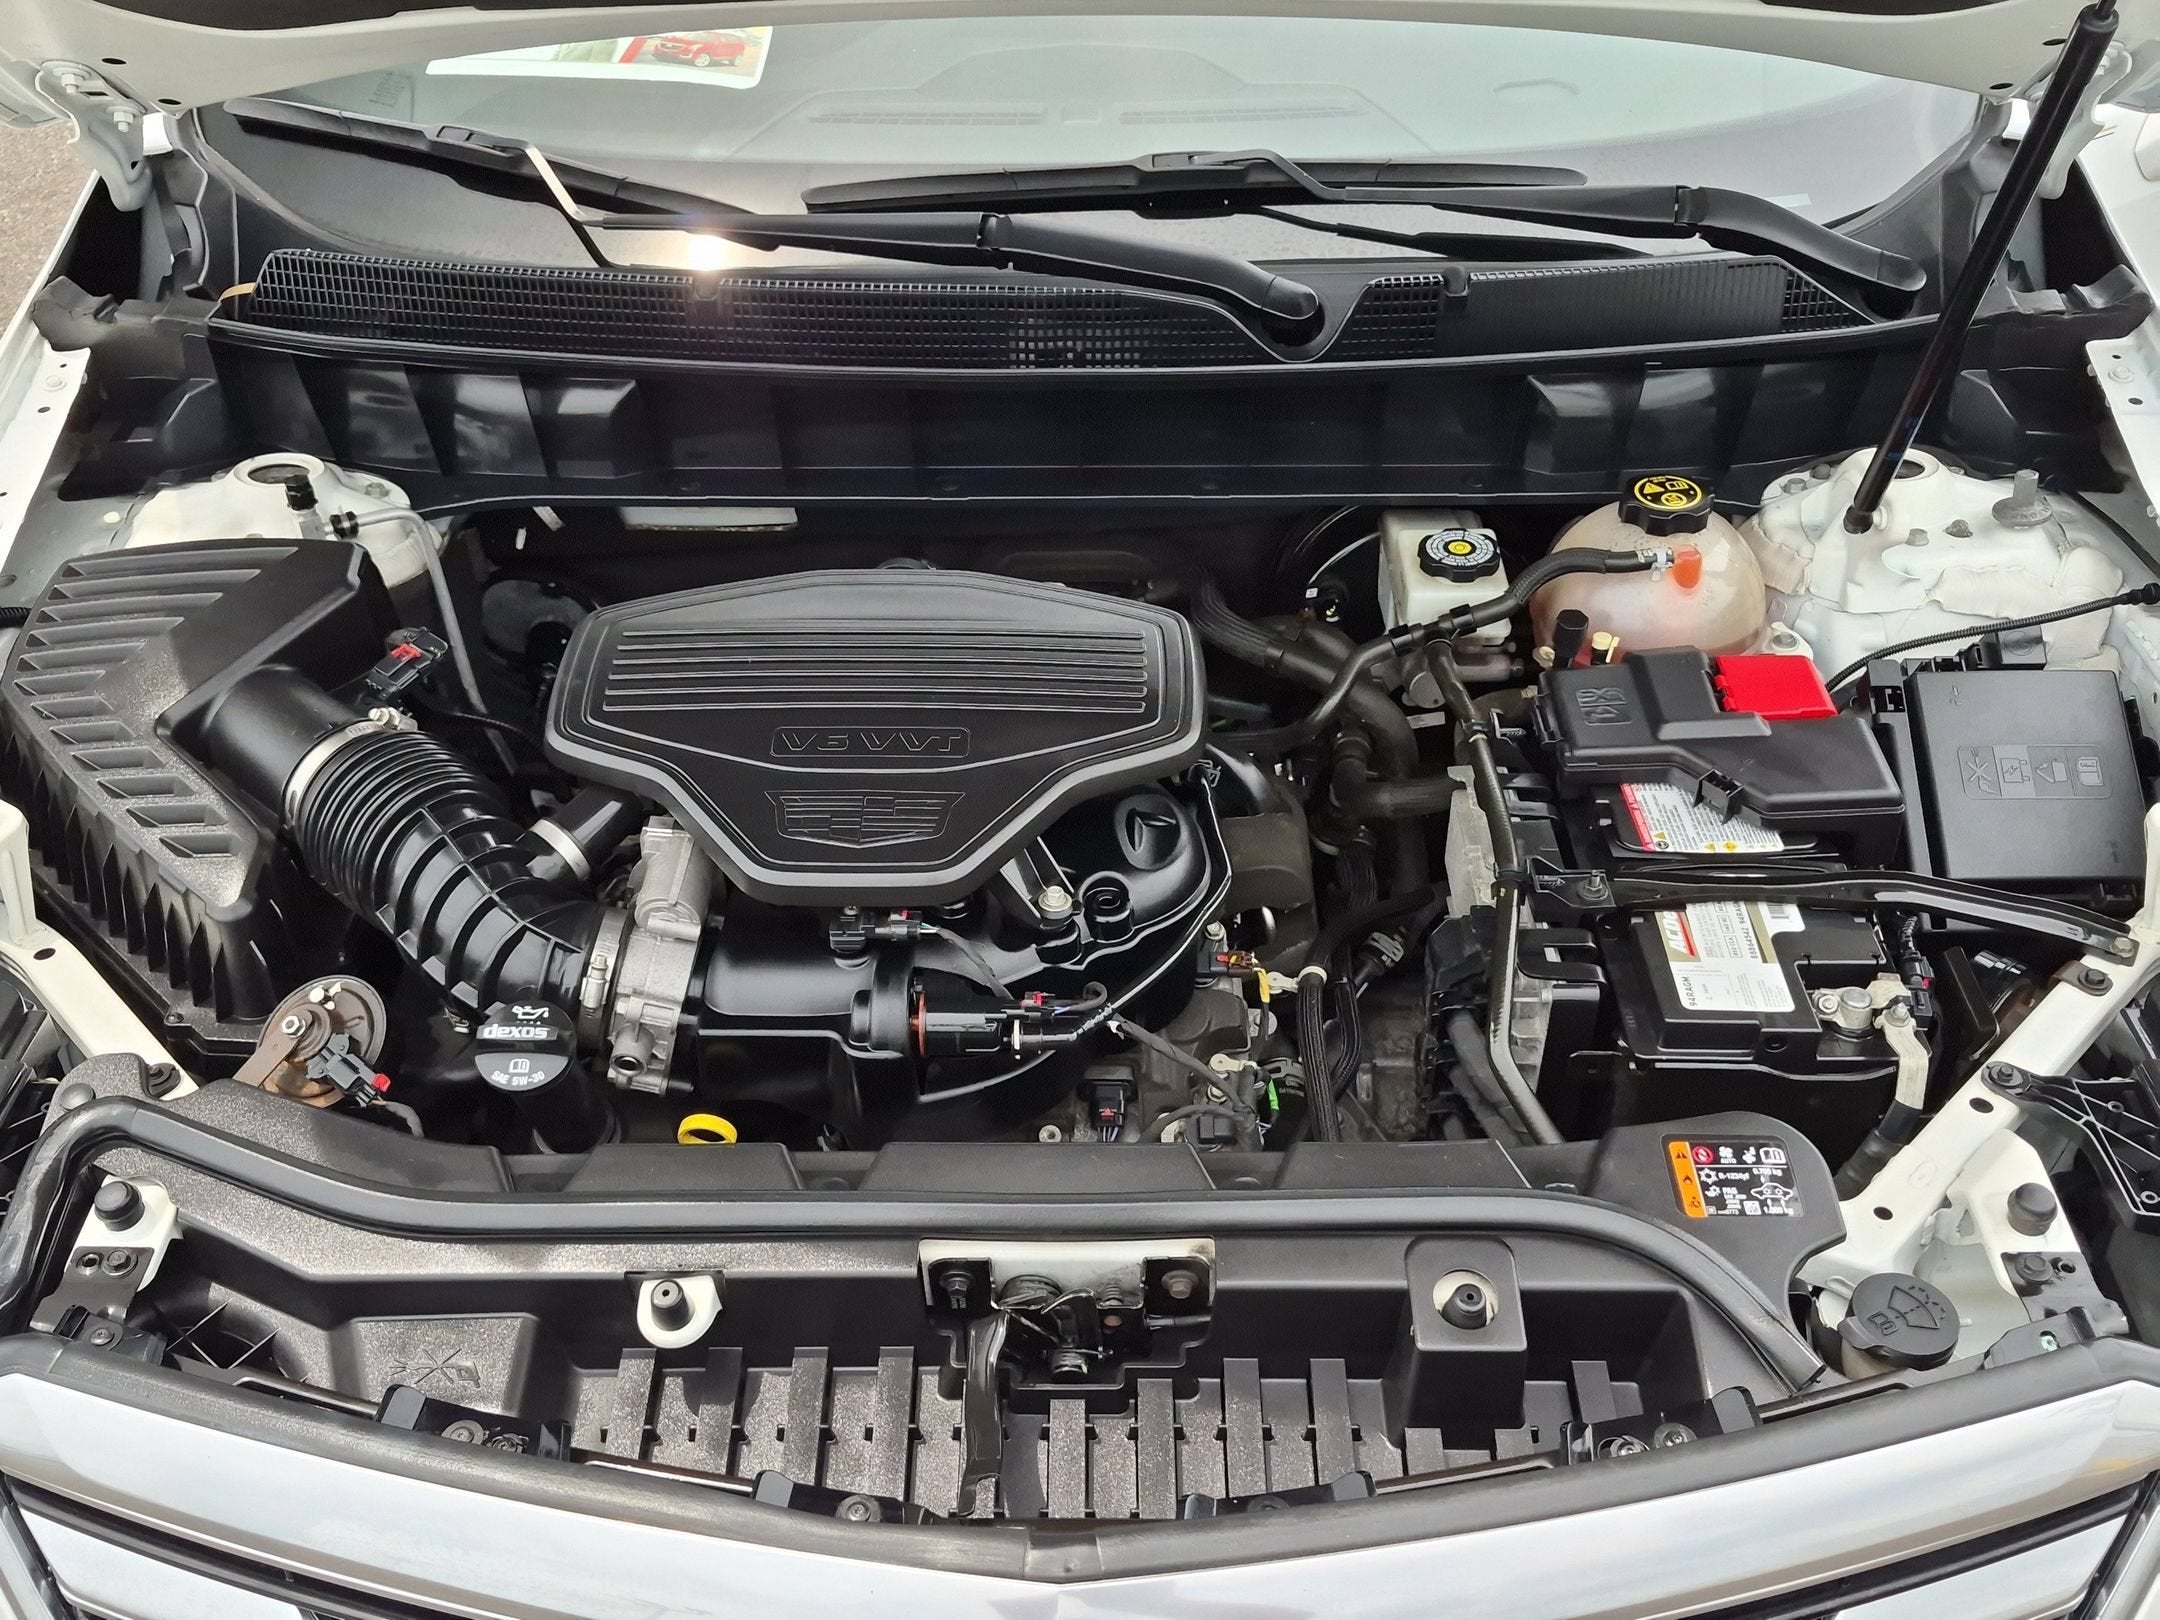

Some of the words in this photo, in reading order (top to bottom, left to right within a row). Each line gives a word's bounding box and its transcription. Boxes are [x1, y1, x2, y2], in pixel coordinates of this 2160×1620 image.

[781, 731, 849, 751] V6
[860, 731, 962, 751] VVT
[1681, 976, 1698, 1006] 94RAGM
[482, 1023, 551, 1040] dexos
[491, 1071, 509, 1085] SAE
[511, 1071, 545, 1086] 5W-30
